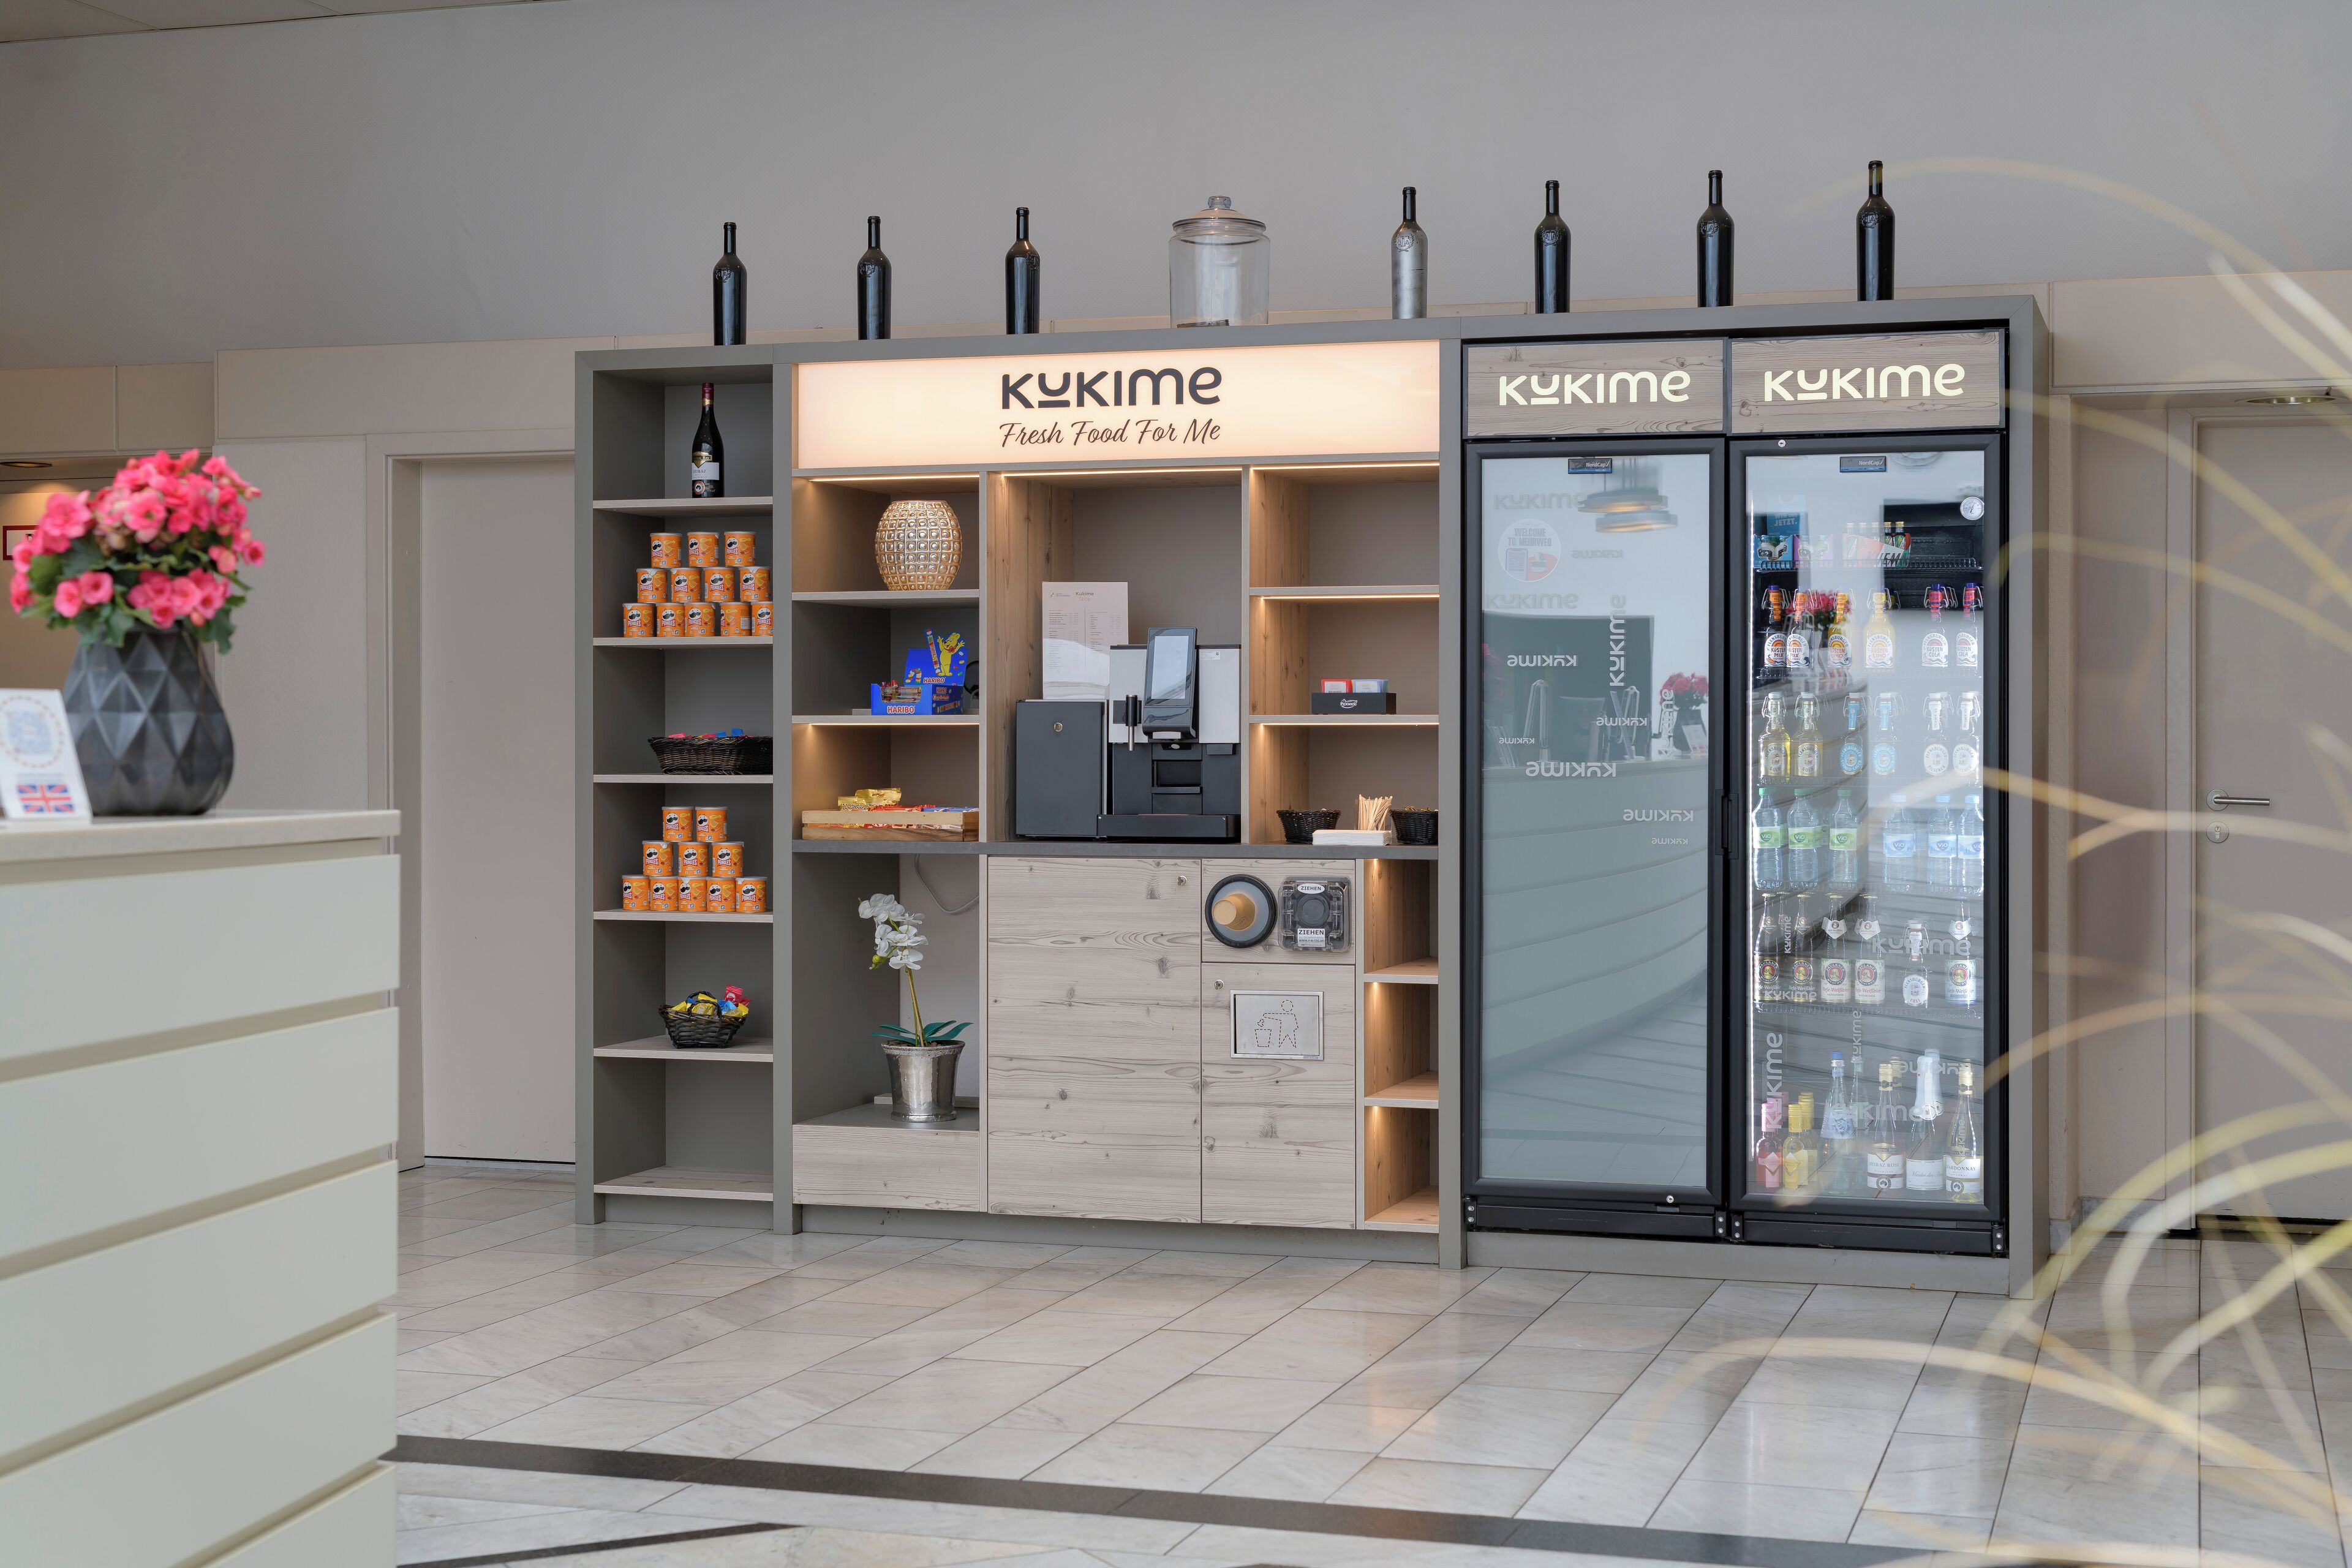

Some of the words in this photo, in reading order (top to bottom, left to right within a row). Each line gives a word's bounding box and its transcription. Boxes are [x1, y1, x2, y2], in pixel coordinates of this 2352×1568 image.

[1000, 421, 1064, 447] Fresh
[1071, 419, 1131, 446] Food
[1136, 419, 1177, 444] For
[1183, 418, 1221, 444] Me
[1514, 528, 1546, 538] WELCOME
[1507, 537, 1516, 546] TO
[1518, 537, 1552, 547] MEHRWEG
[887, 706, 915, 714] HARIBO
[1858, 963, 1877, 972] PAULANER
[1950, 964, 1968, 973] PAULANE
